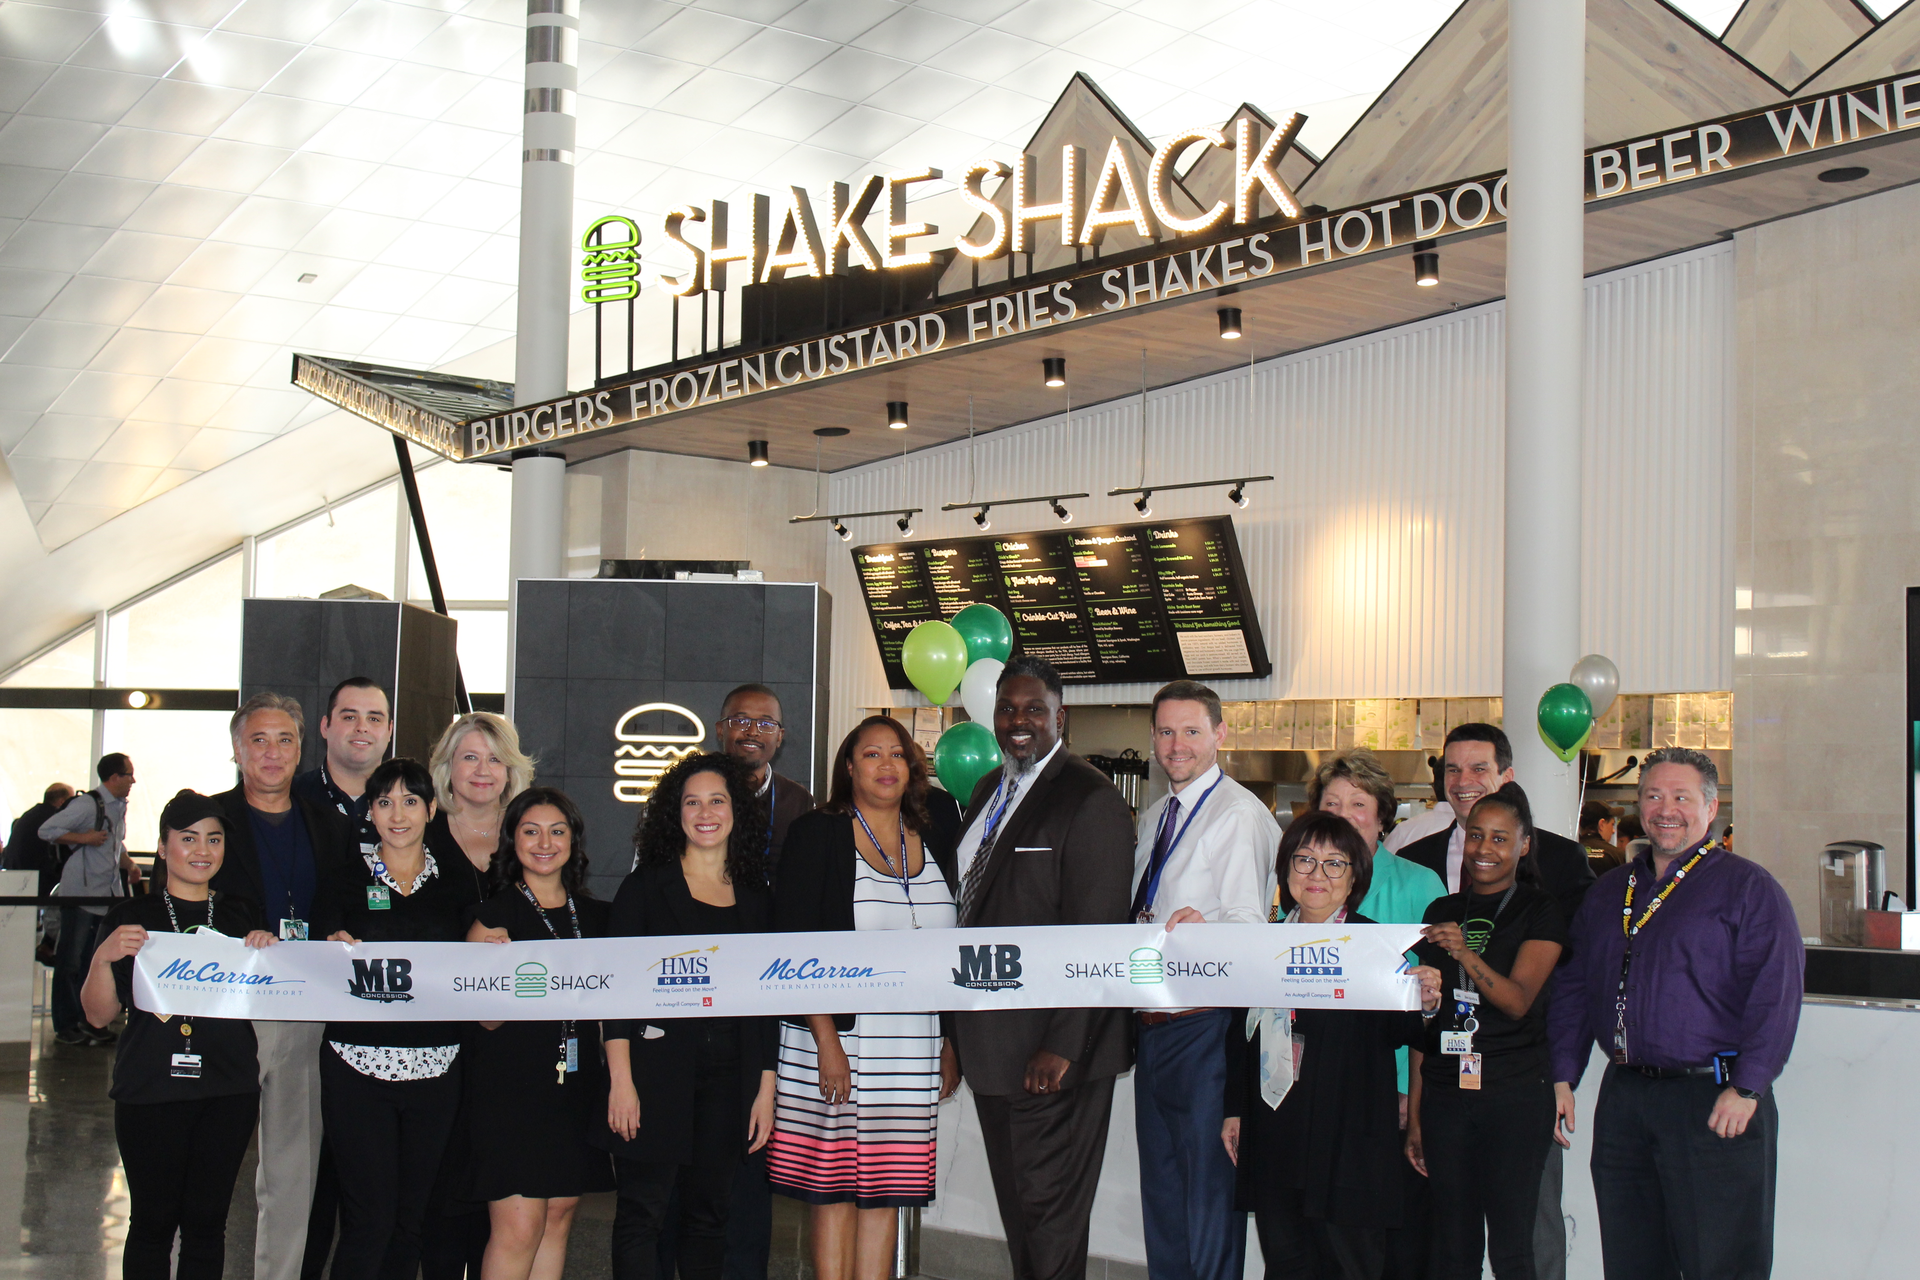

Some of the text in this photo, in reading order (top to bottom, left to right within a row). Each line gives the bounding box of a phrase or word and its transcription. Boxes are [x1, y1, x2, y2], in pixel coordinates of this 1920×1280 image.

[655, 112, 1309, 297] SHAKE SHACK
[470, 391, 613, 456] BURGERS
[630, 353, 766, 419] FROZEN
[774, 313, 946, 384] CUSTARD
[967, 282, 1076, 342] FRIES
[1101, 234, 1274, 311] SHAKES
[1299, 200, 1400, 265] HOT
[1592, 124, 1732, 198] BEER
[1764, 75, 1920, 154] WINE
[1115, 534, 1137, 542] Custard
[1153, 529, 1178, 539] Drinks
[931, 548, 958, 558] Burgers
[1002, 542, 1029, 551] Chicken
[1010, 575, 1056, 587] Flat-Top Dogs
[1022, 611, 1077, 621] Crinkle-Cut Fries
[1094, 608, 1112, 616] Beer
[1118, 606, 1137, 615] Wine
[884, 621, 902, 630] Coffee,
[959, 944, 1022, 980] MB
[1289, 946, 1340, 965] HMS
[158, 958, 305, 985] McCarran
[660, 956, 708, 975] HMS
[759, 958, 906, 981] McCarran
[1065, 961, 1125, 978] SHAKE
[352, 959, 412, 992] MB
[158, 983, 250, 995] INTERNATIONAL
[453, 976, 511, 992] SHAKE
[1448, 1039, 1465, 1047] HMS
